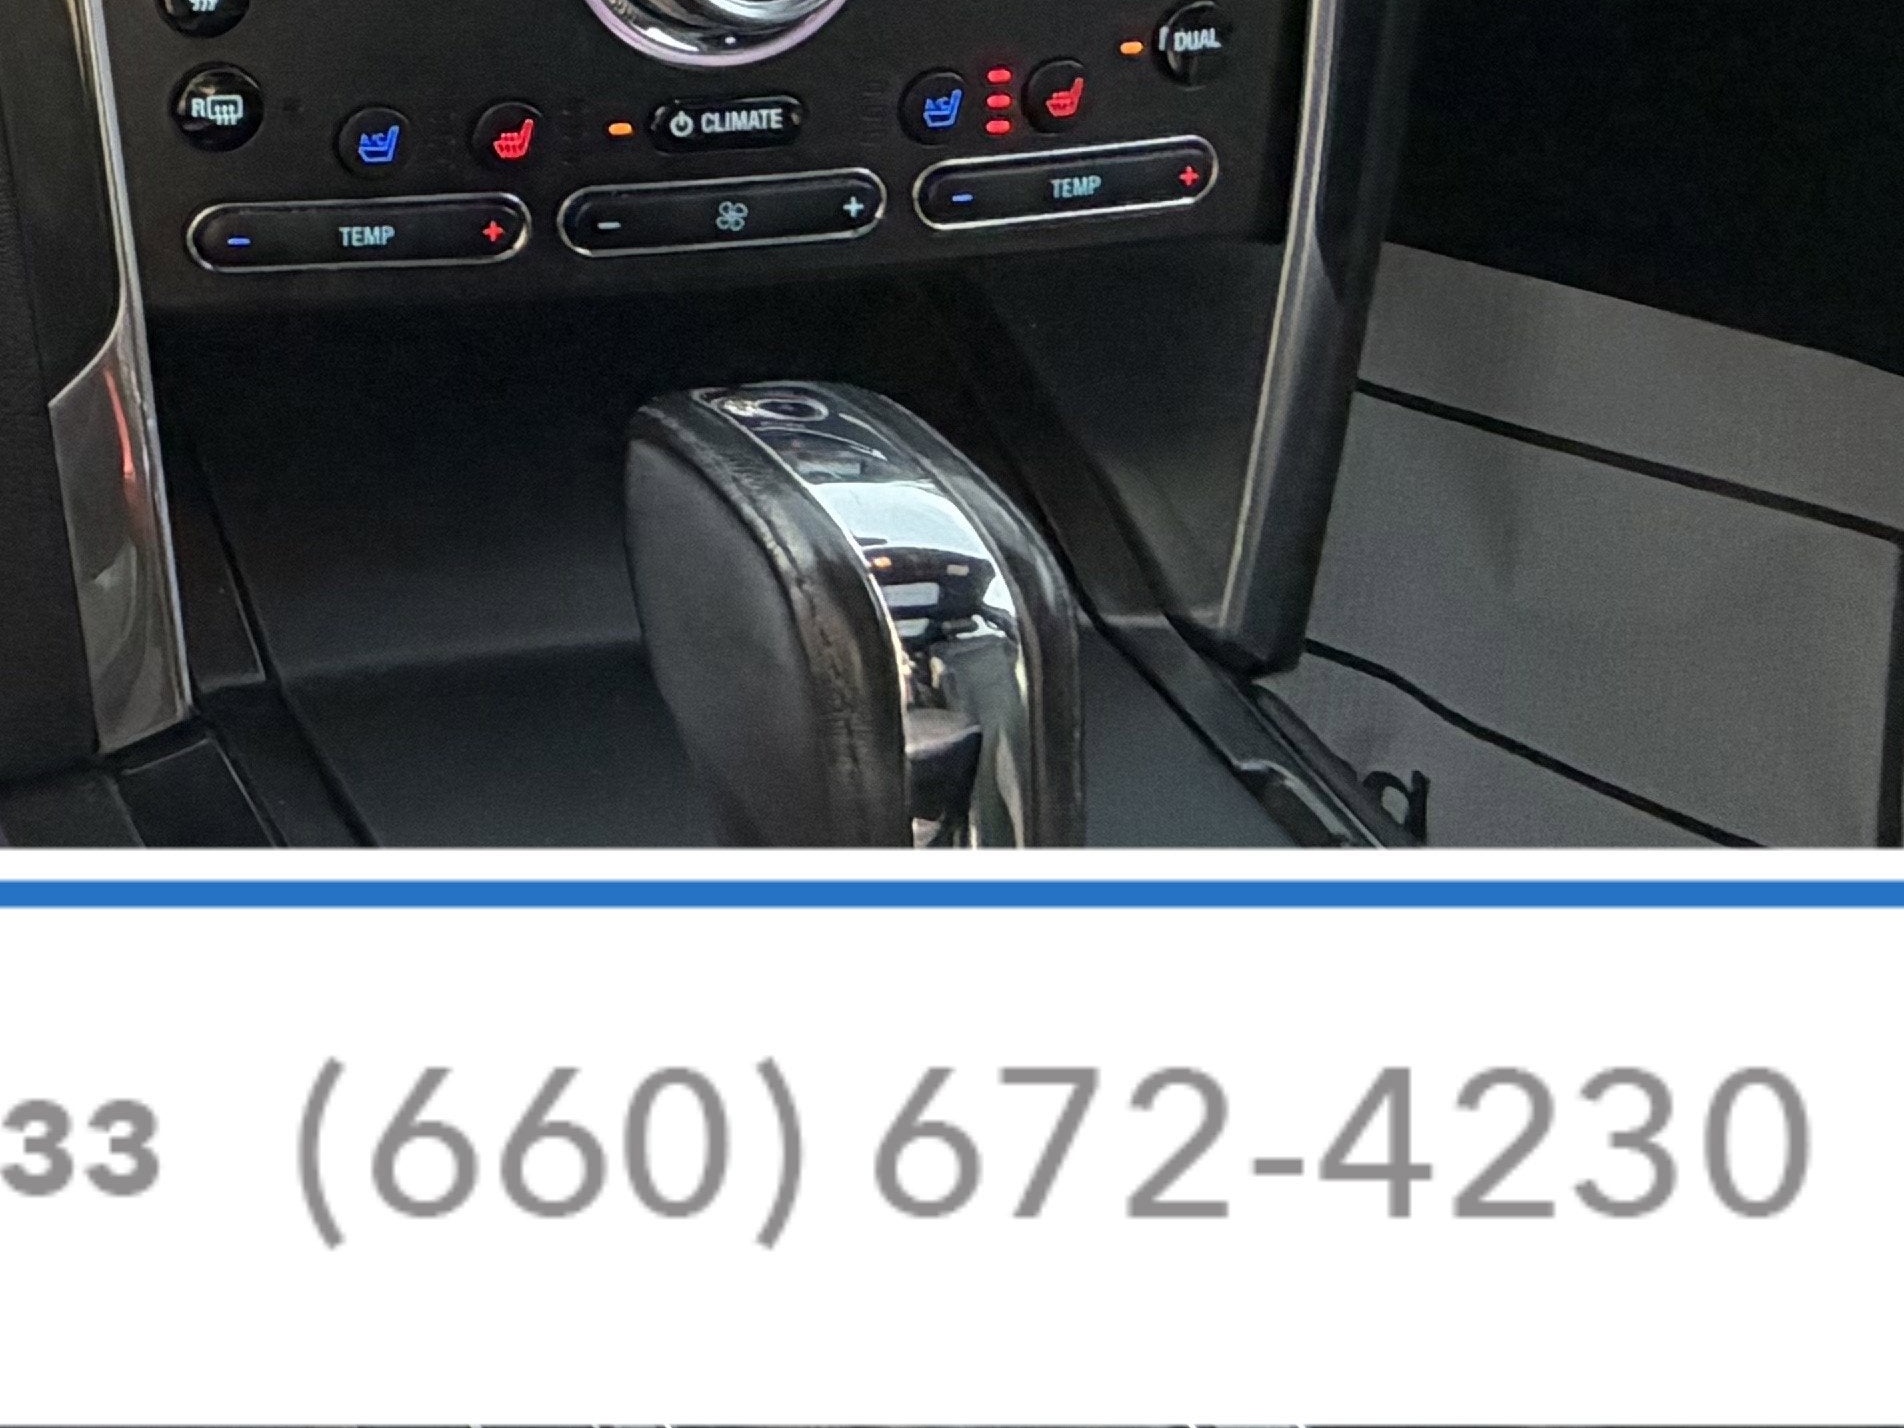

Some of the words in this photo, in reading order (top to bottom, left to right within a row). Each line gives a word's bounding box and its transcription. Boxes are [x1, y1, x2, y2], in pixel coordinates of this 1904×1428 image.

[1173, 28, 1222, 52] DUAL
[701, 108, 784, 134] CLIMATE
[1049, 175, 1102, 199] TEMP
[339, 226, 396, 247] TEMP
